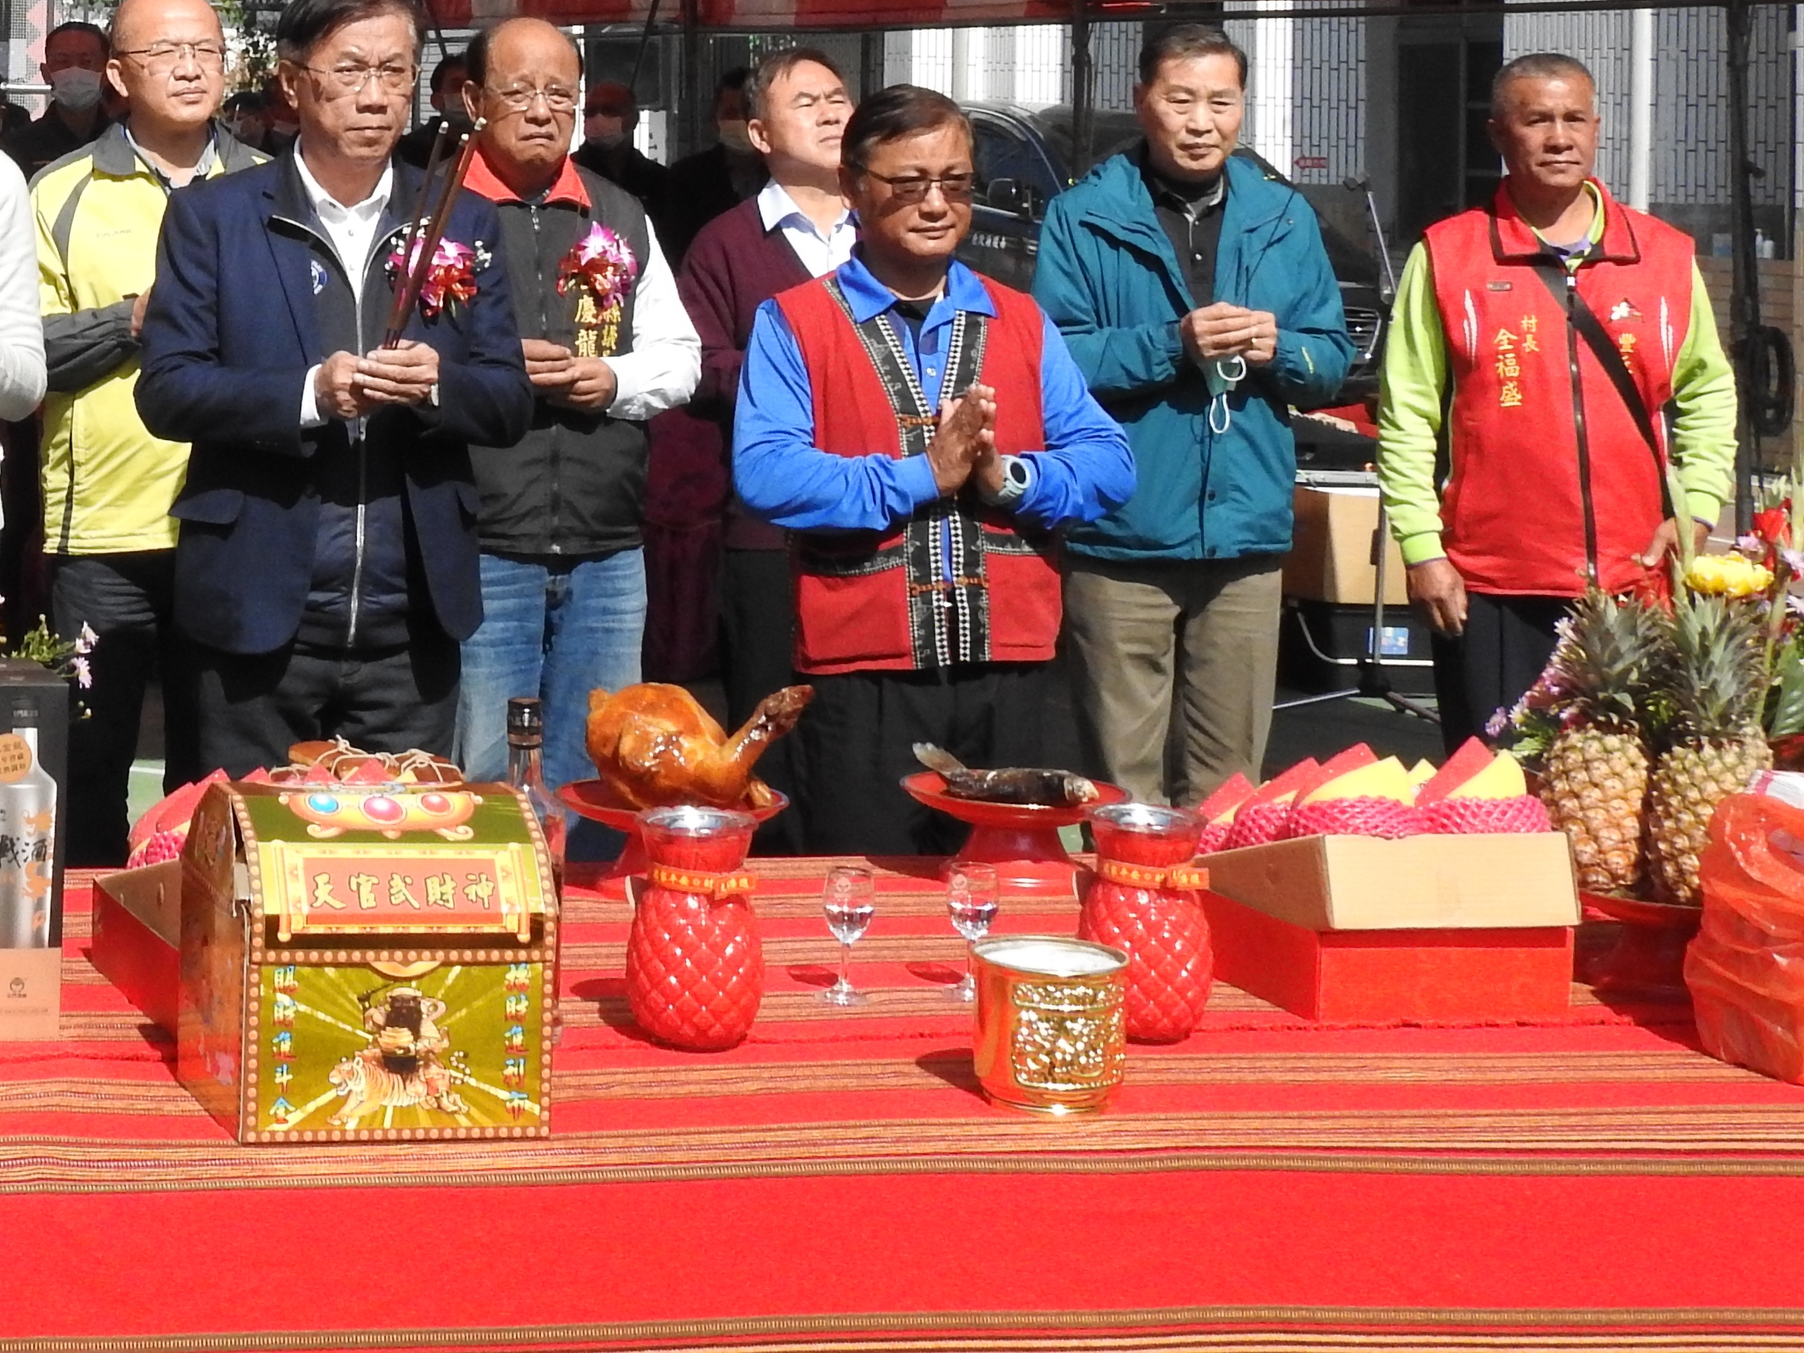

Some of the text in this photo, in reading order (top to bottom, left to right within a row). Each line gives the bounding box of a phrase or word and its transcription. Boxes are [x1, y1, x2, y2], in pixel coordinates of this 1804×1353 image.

[568, 283, 598, 357] 慶龍
[1521, 315, 1539, 352] 村長
[1494, 329, 1522, 407] 全福盛
[311, 872, 495, 910] 天官武財神
